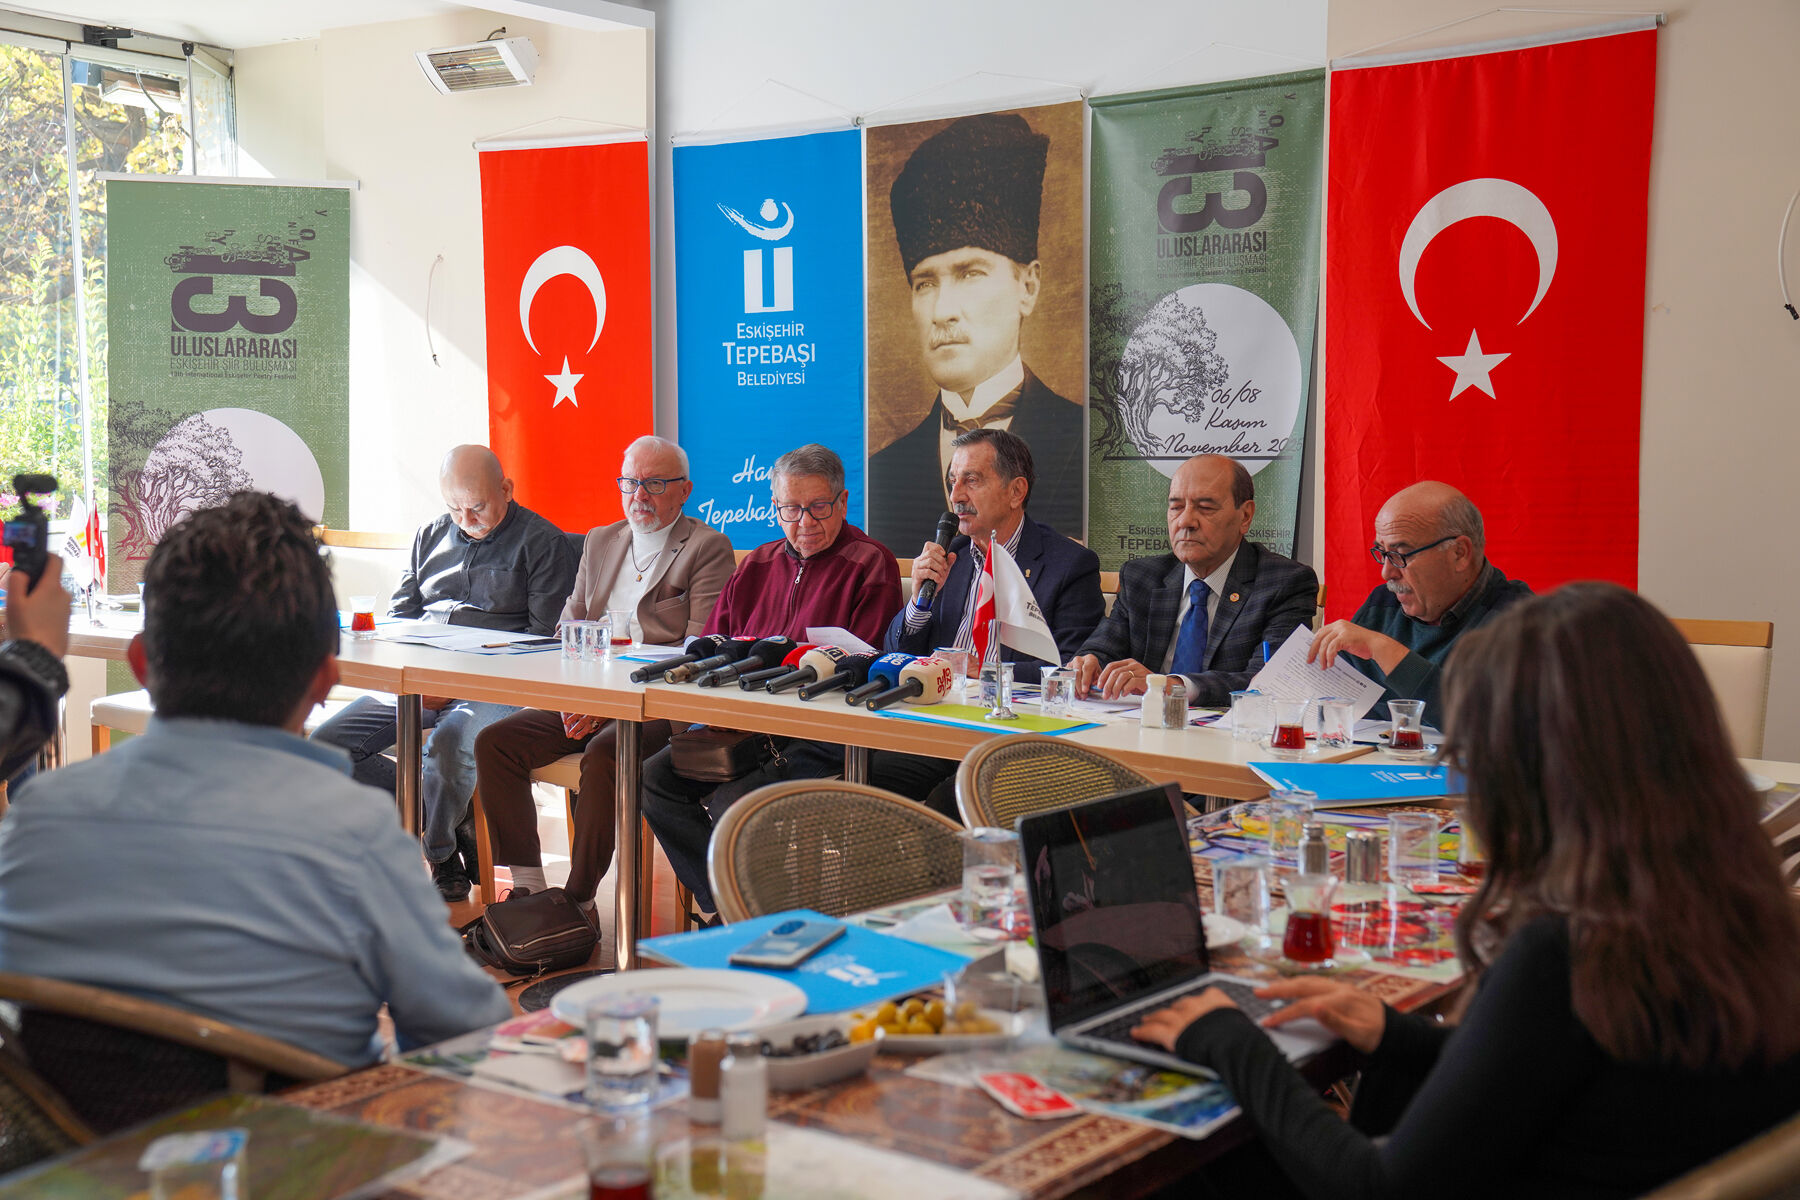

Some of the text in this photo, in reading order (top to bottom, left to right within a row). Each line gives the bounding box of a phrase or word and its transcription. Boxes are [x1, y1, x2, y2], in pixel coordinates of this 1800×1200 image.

[1157, 231, 1267, 259] ULUSLARARASI
[170, 336, 298, 359] ULUSLARARASI
[722, 342, 816, 368] TEPEBAŞI
[737, 369, 806, 386] BELEDİYESİ
[1211, 379, 1262, 410] 06/08
[1204, 406, 1268, 431] Kasım
[1164, 430, 1262, 454] November
[697, 493, 778, 534] Tepebaş
